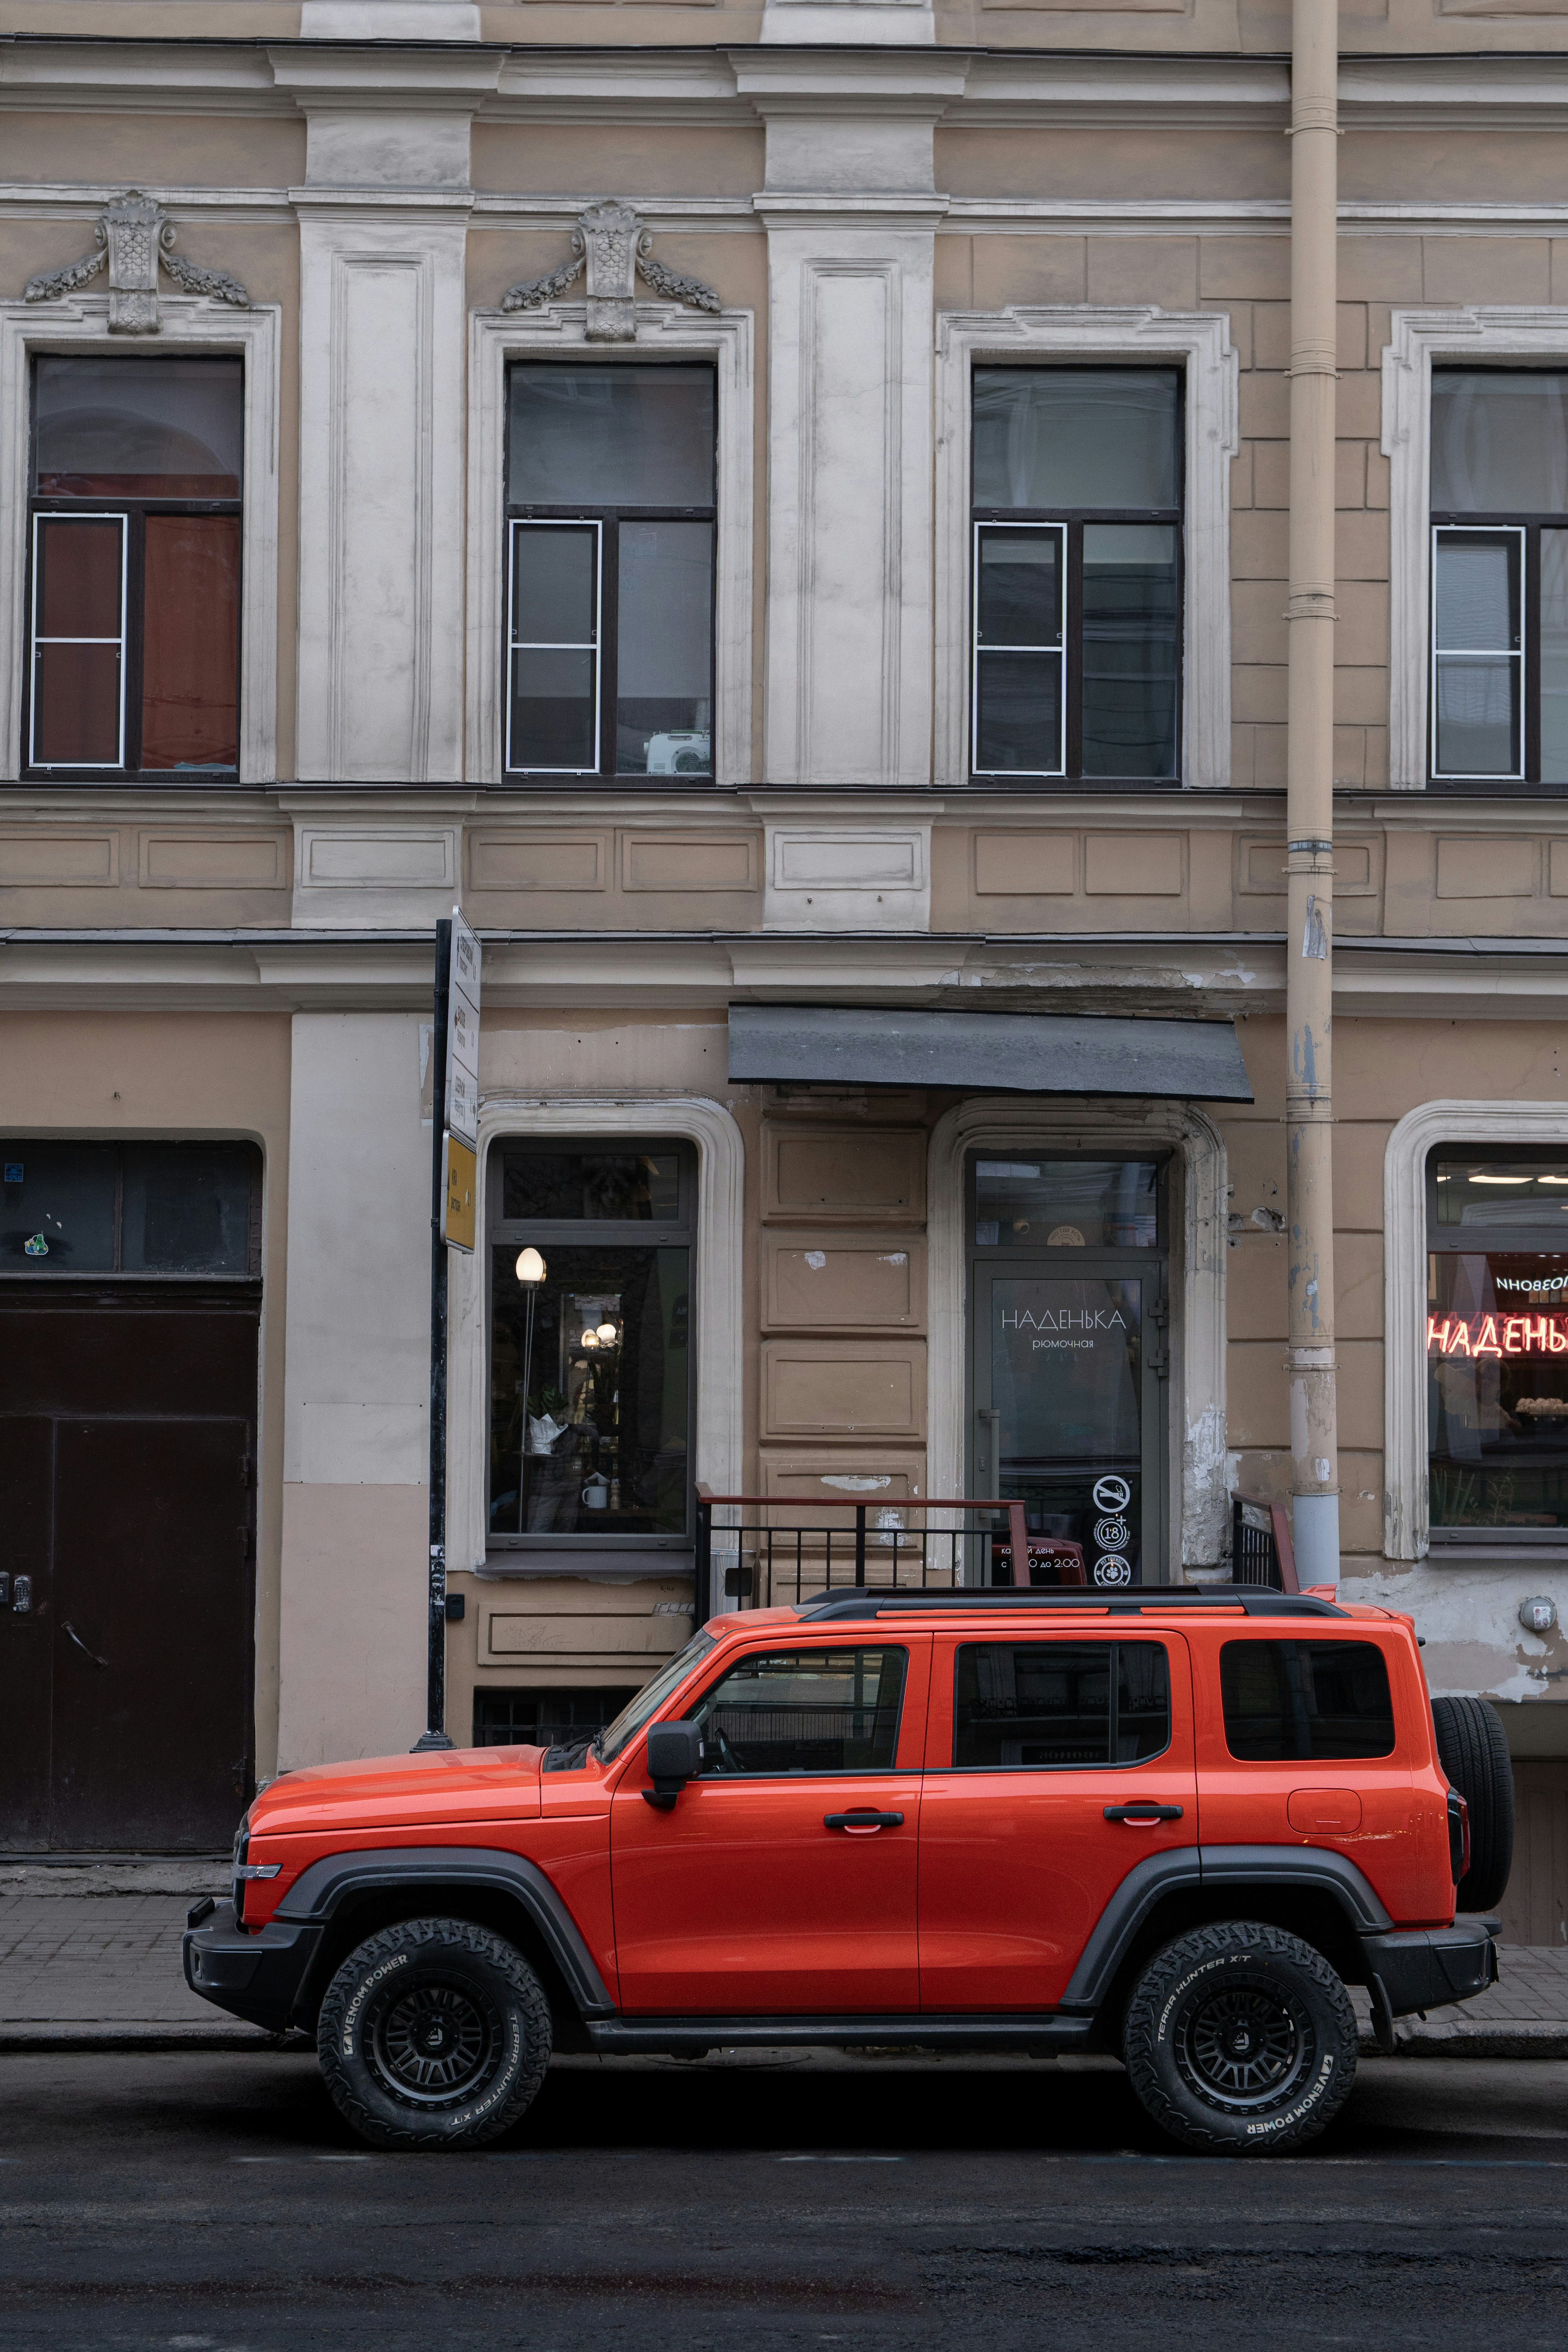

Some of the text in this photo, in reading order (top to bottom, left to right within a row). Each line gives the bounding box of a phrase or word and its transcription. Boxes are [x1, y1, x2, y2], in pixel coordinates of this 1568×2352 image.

[1050, 1231, 1059, 1240] ЧТО
[1071, 1230, 1081, 1241] ЕСТЬ
[1002, 1309, 1127, 1331] НАДЕНЬКА
[1032, 1340, 1094, 1350] рюмочная
[1054, 1559, 1080, 1567] 2:00
[1095, 1540, 1107, 1551] алкоголь
[1118, 1540, 1128, 1550] младше
[343, 1954, 408, 2034] VENOM POWER
[1157, 1995, 1176, 2042] TERRA
[1176, 1957, 1225, 1995] HUNTER
[505, 2014, 520, 2063] TERRA
[475, 2066, 514, 2116] HUNTER
[1247, 2073, 1329, 2134] VENOM POWER
